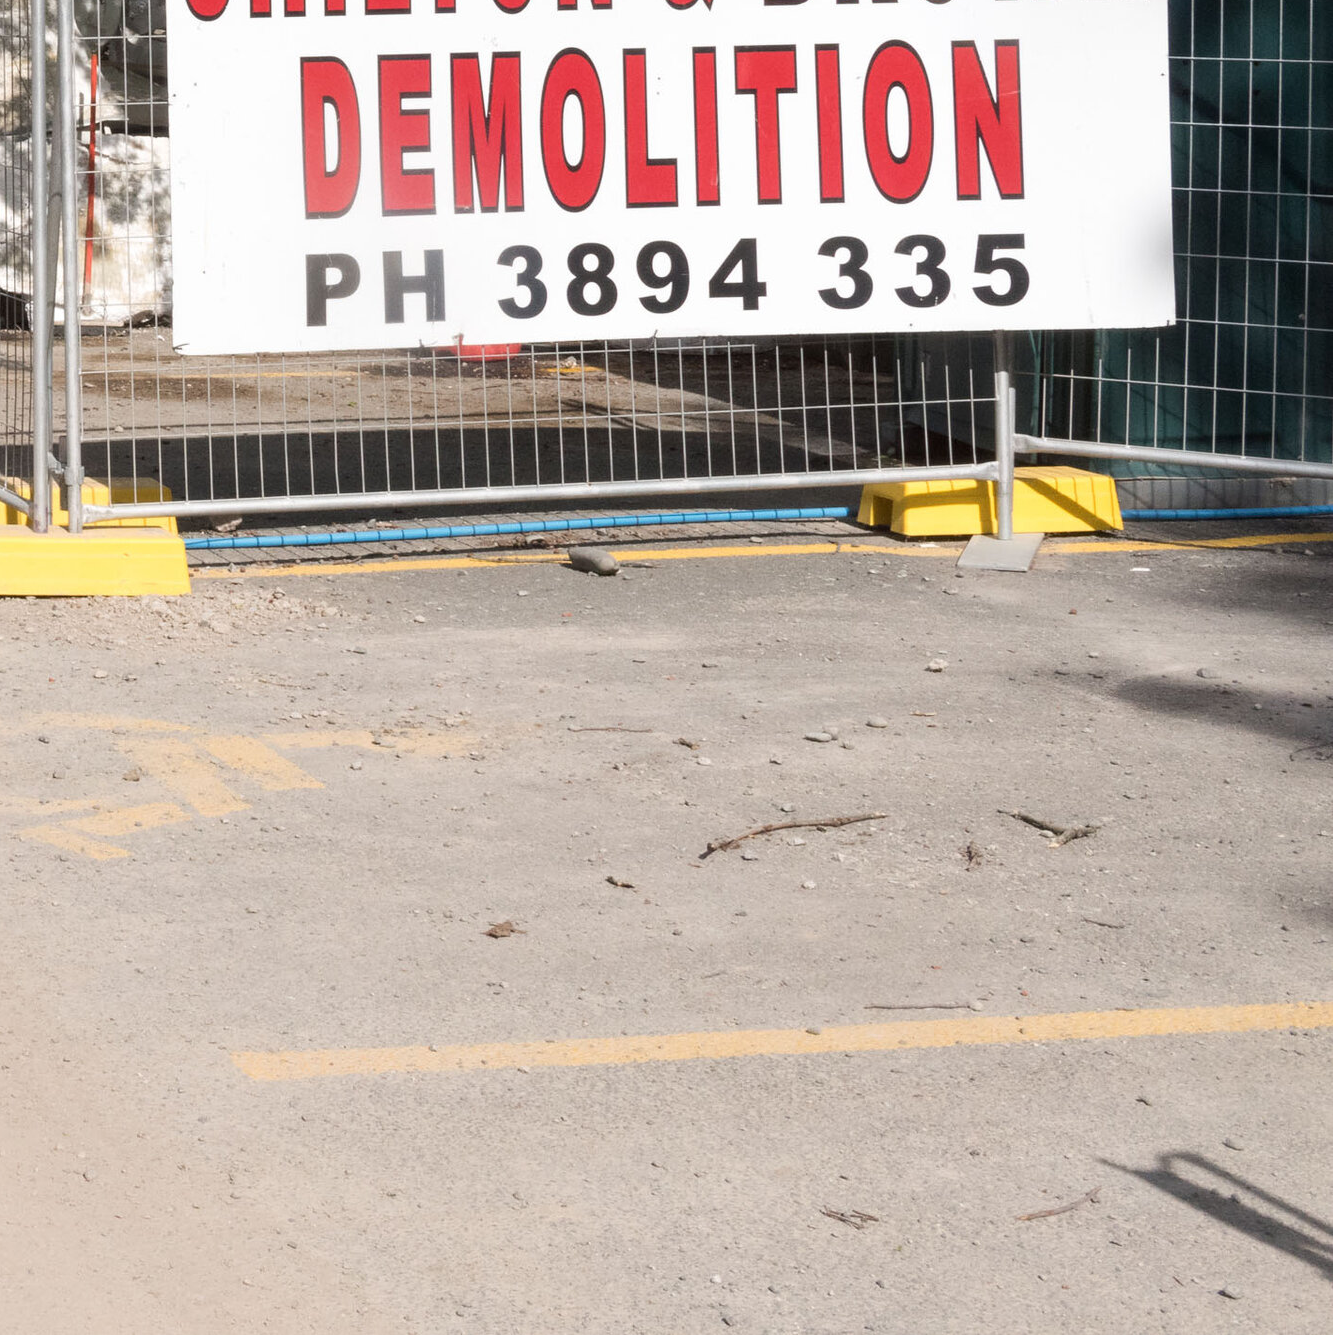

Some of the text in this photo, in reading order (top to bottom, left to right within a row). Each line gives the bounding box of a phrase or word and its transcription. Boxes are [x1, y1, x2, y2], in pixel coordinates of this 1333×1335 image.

[299, 38, 1024, 220] DEMOLITION
[304, 231, 1031, 327] PH 3894 335
